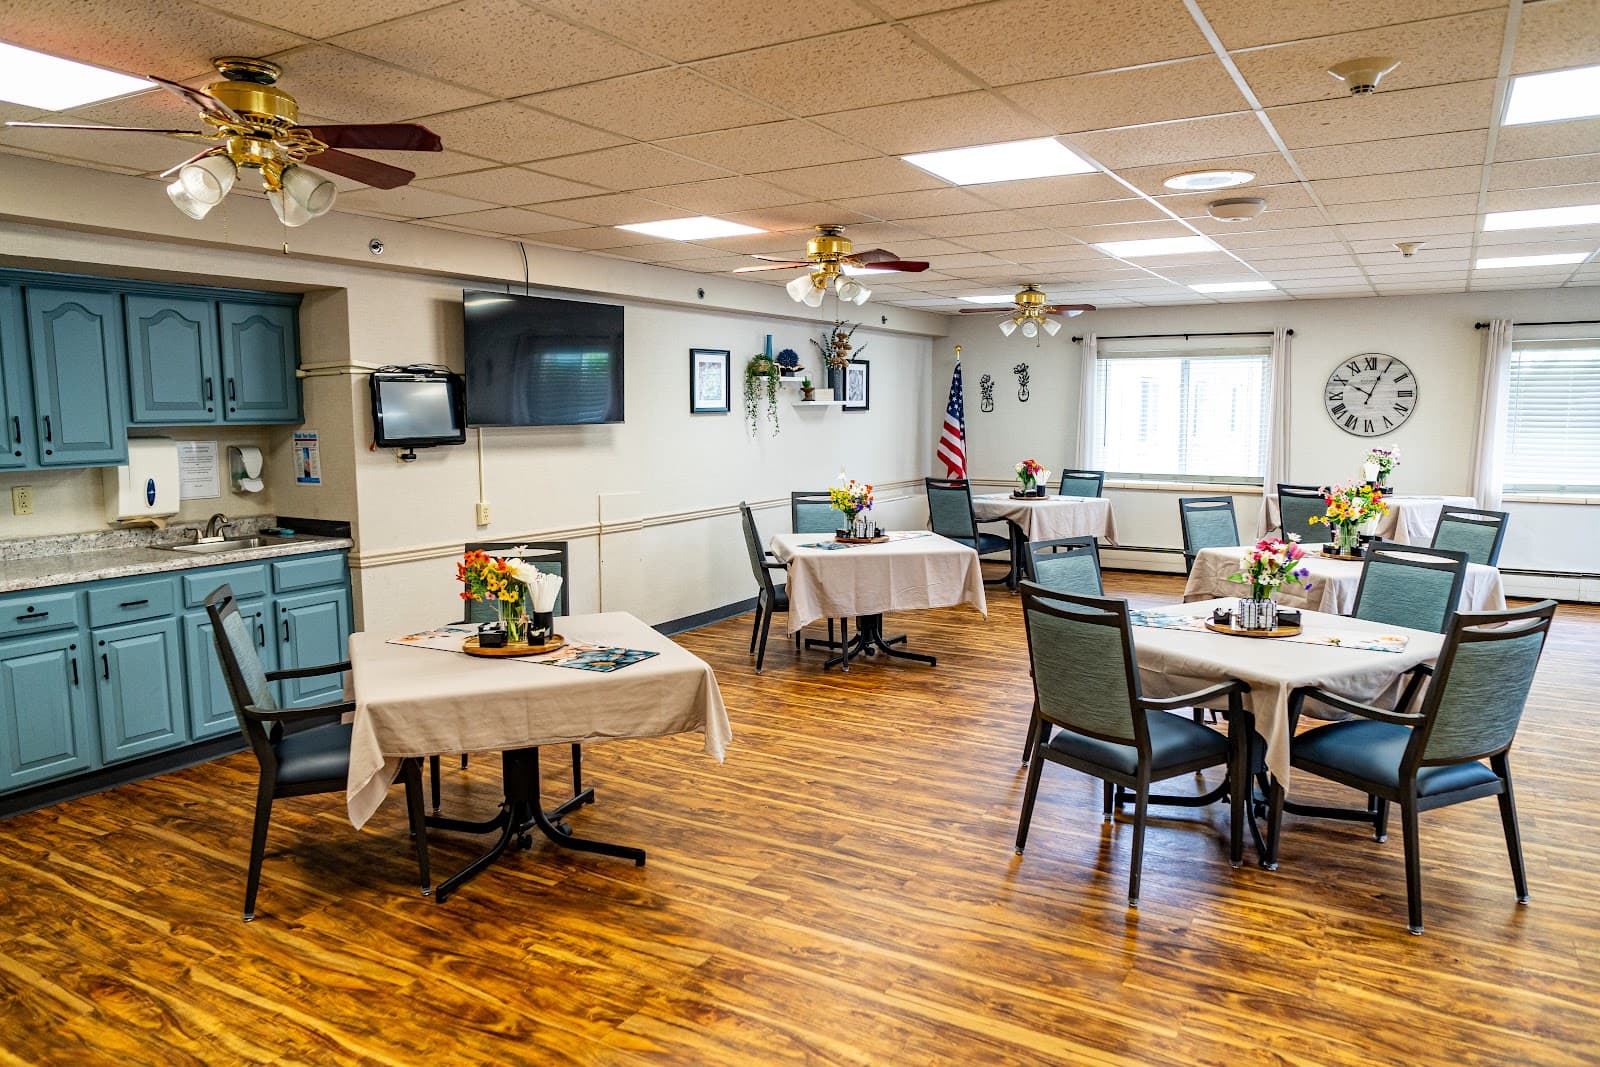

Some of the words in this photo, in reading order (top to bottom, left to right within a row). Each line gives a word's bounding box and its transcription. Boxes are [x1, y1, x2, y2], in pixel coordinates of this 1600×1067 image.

[1346, 361, 1361, 376] XI
[1364, 357, 1377, 371] XII
[1383, 360, 1393, 373] I
[1333, 374, 1349, 386] X
[1393, 373, 1409, 383] II
[1329, 391, 1344, 401] IX
[1397, 390, 1413, 398] III
[1331, 403, 1348, 419] VIII
[1393, 403, 1409, 416] IV
[1344, 414, 1358, 430] VII
[1364, 419, 1374, 432] VI
[1383, 415, 1394, 429] V
